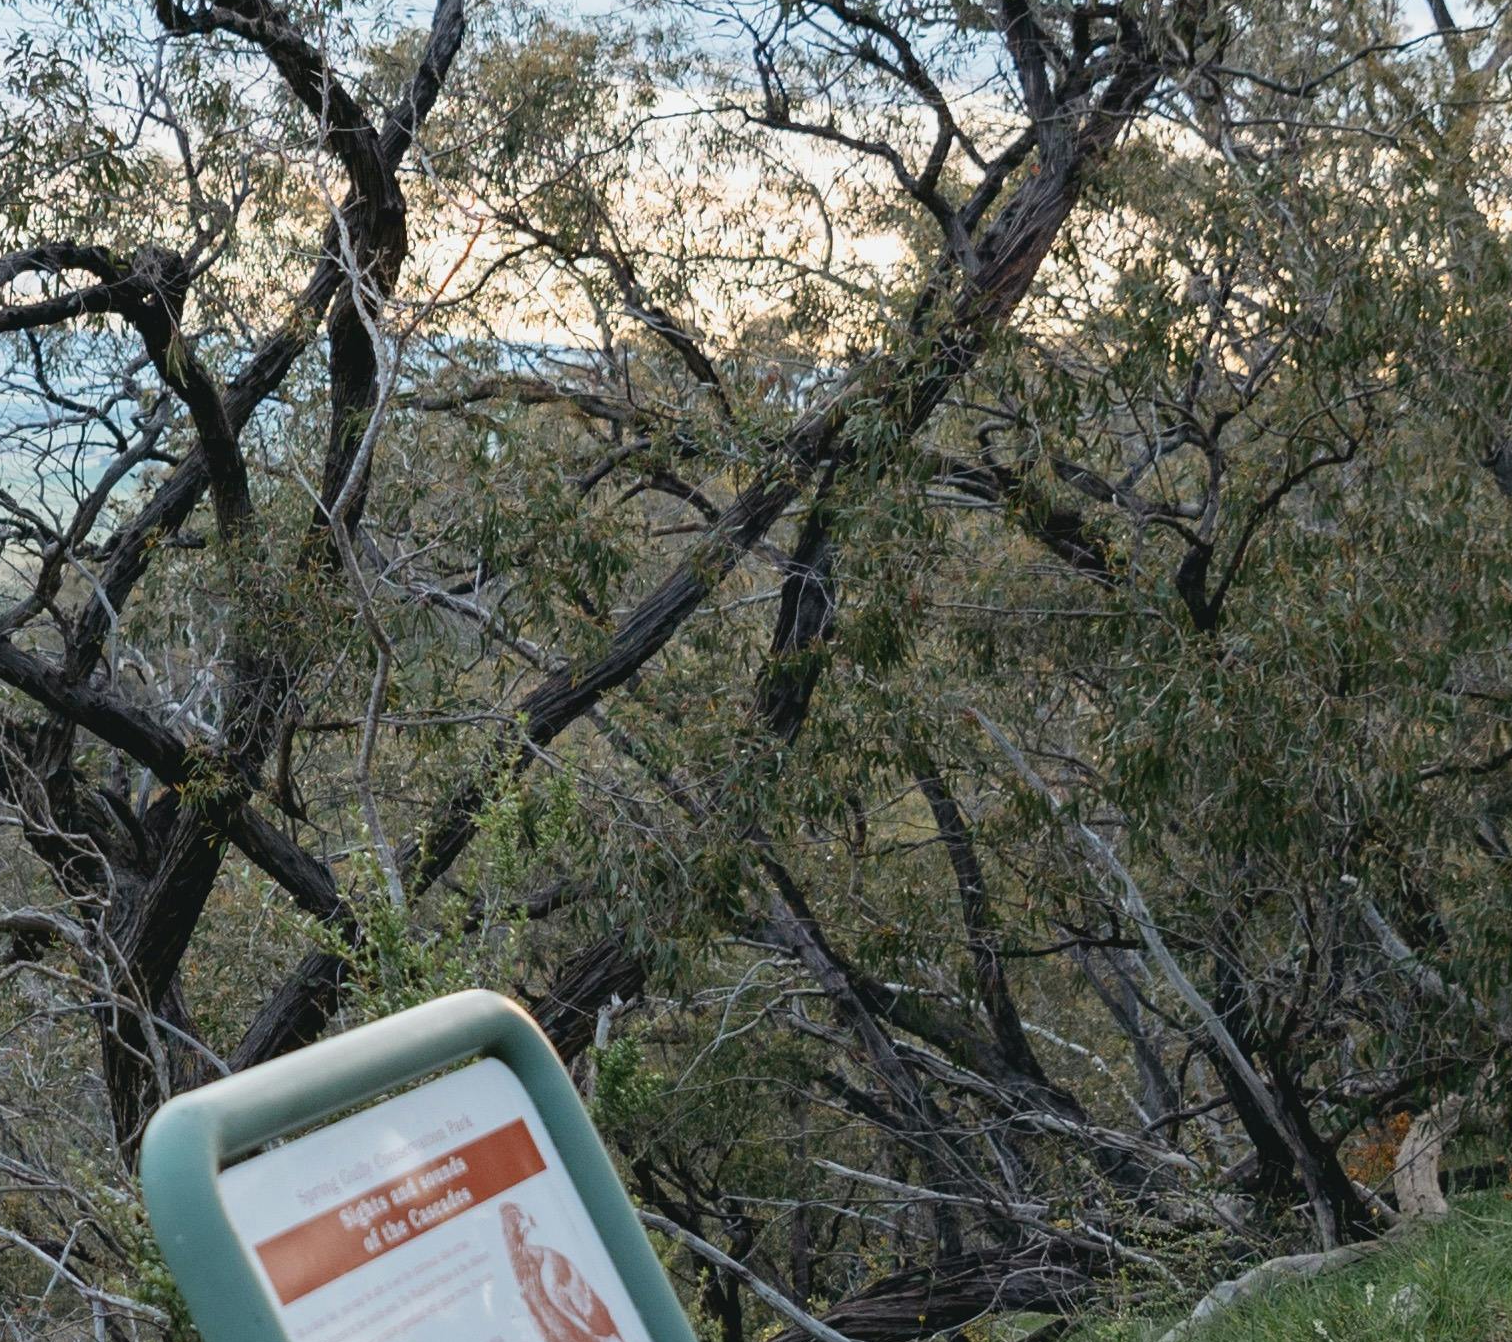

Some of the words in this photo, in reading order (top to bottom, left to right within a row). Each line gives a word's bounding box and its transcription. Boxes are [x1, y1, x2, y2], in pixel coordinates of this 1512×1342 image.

[445, 1113, 474, 1135] Park
[339, 1194, 390, 1231] Sights
[390, 1177, 418, 1206] and
[418, 1156, 469, 1192] sounds
[363, 1226, 383, 1254] of
[381, 1219, 409, 1244] the
[408, 1187, 473, 1228] Cascades
